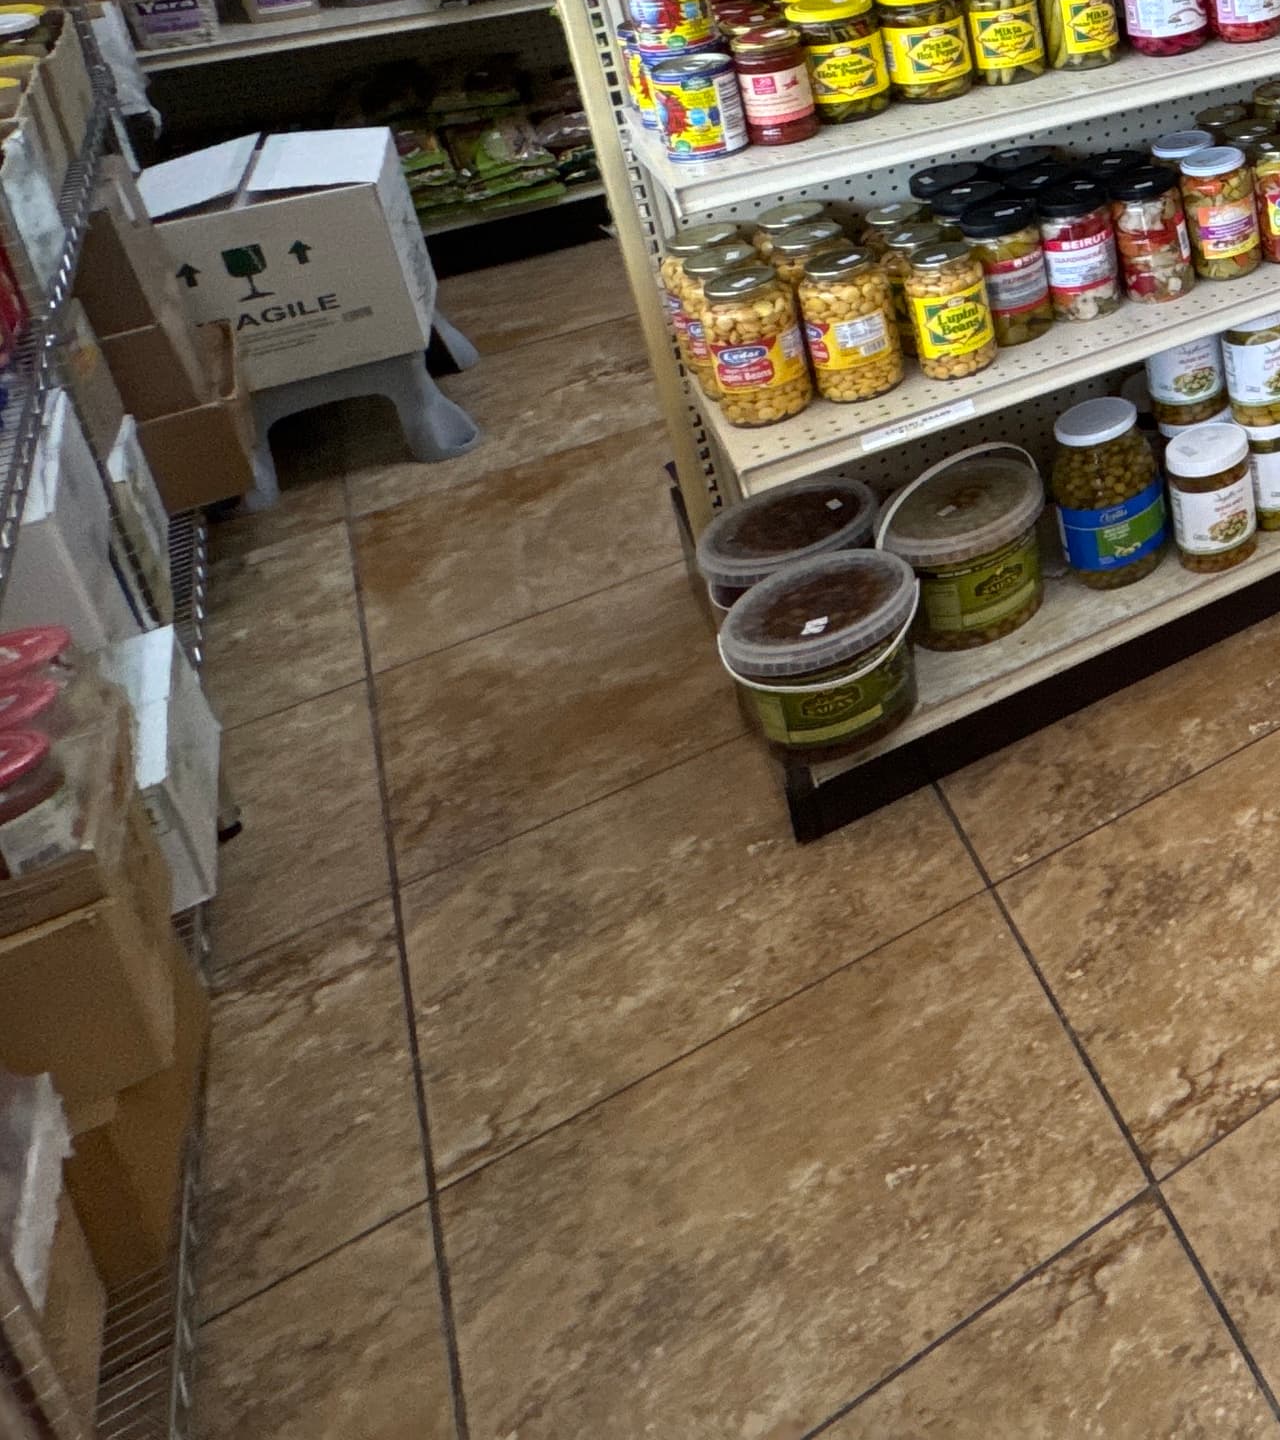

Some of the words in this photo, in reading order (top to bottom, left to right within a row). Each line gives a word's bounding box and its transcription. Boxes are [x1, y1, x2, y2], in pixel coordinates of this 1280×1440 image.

[994, 25, 1022, 38] Miksa
[1061, 231, 1108, 251] BEIRUT
[234, 292, 341, 331] AGILE
[937, 304, 979, 328] Lupini
[943, 319, 978, 338] Beans
[722, 349, 761, 363] Cedar
